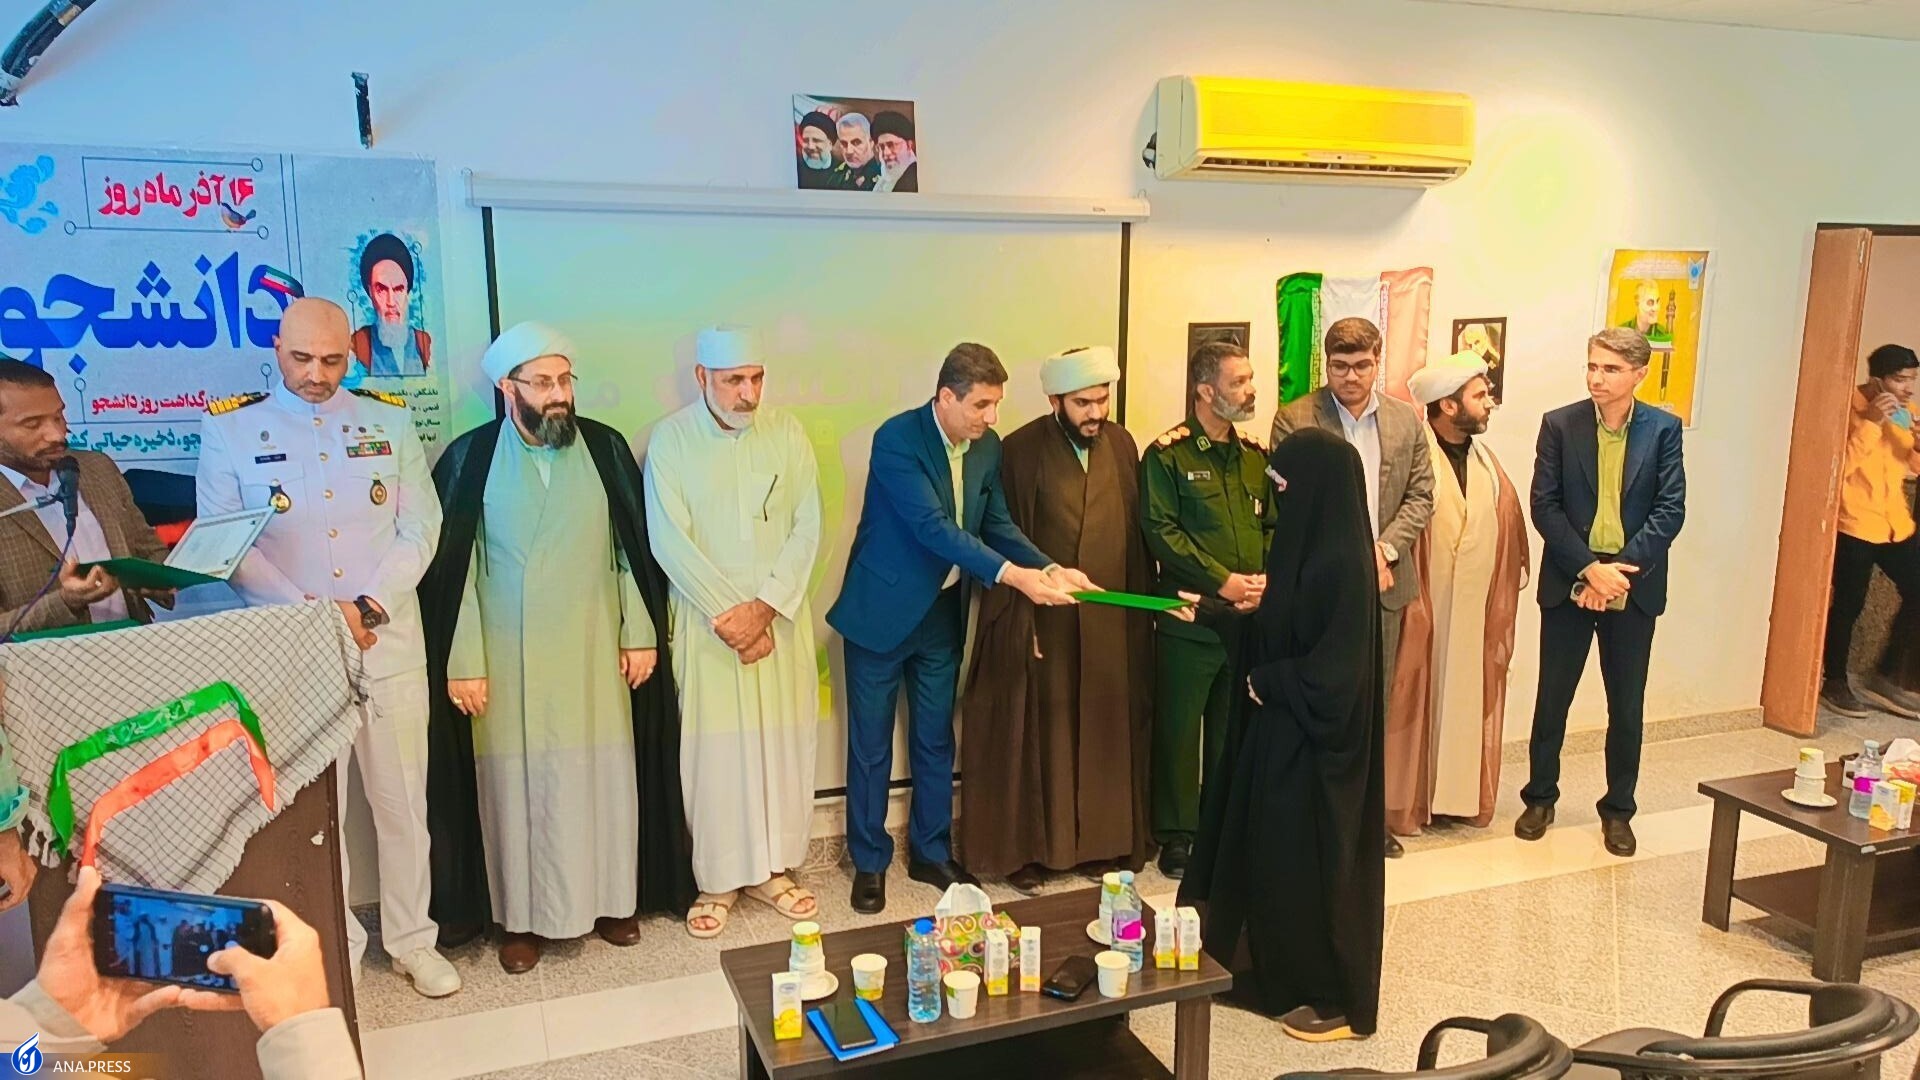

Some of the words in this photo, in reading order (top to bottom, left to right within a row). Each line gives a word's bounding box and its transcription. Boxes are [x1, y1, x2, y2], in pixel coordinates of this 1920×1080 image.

[97, 176, 141, 216] روز
[144, 172, 182, 207] ماه
[182, 170, 226, 218] آذر
[0, 251, 305, 375] دانشجو
[92, 392, 138, 415] دانشجو
[138, 393, 160, 414] روز
[91, 431, 132, 453] حیاتی
[134, 427, 176, 453] ذخیره
